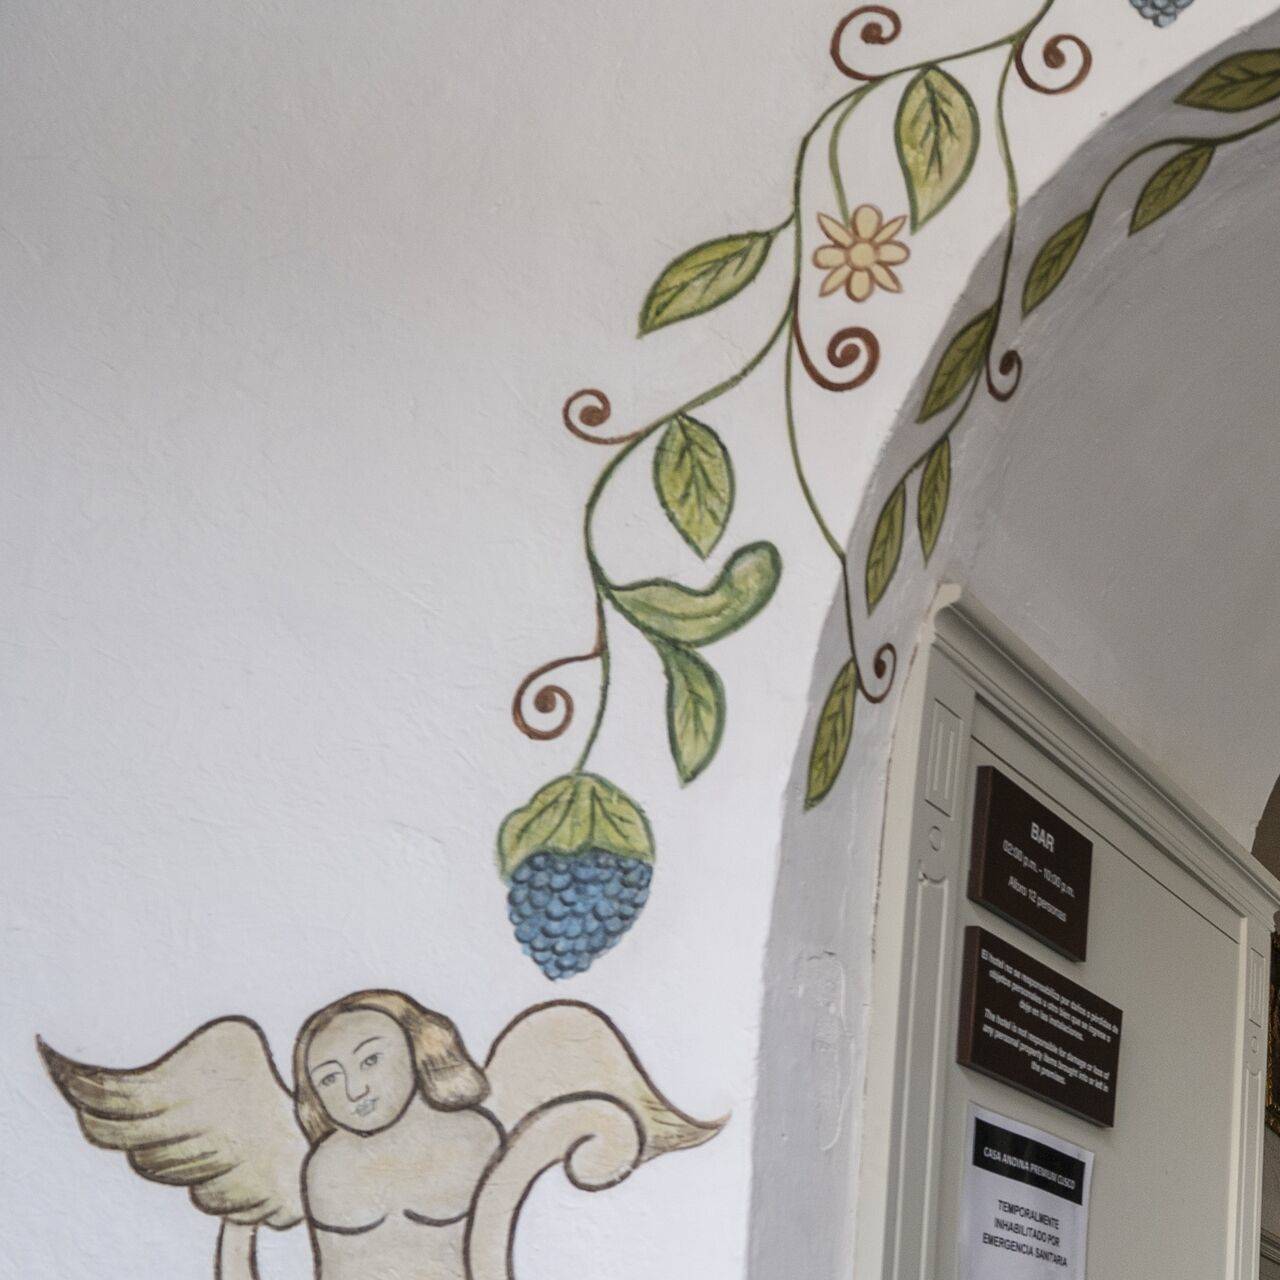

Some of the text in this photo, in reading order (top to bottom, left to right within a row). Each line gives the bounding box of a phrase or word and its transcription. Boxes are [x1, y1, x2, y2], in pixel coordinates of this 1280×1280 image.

[1030, 822, 1055, 852] BAR
[1027, 889, 1036, 902] 12
[1036, 896, 1066, 923] personas
[989, 954, 1003, 969] hotel
[1011, 982, 1041, 1005] personales
[982, 1024, 993, 1036] any
[994, 1029, 1018, 1048] personal
[1019, 1042, 1042, 1060] property
[1057, 1060, 1077, 1077] brought
[984, 1008, 995, 1021] The
[996, 1015, 1010, 1029] hotel
[1018, 1027, 1026, 1037] not
[1028, 1033, 1057, 1054] responsible
[1066, 1052, 1085, 1069] damage
[1030, 1061, 1040, 1071] the
[983, 1146, 1075, 1189] CASA ANDINA PREMIUM CUSCO
[998, 1199, 1059, 1229] TEMPORALMENTE
[994, 1217, 1059, 1246] INHABILITADO POR
[982, 1232, 1067, 1266] EMERGENCIA SANITARIA
